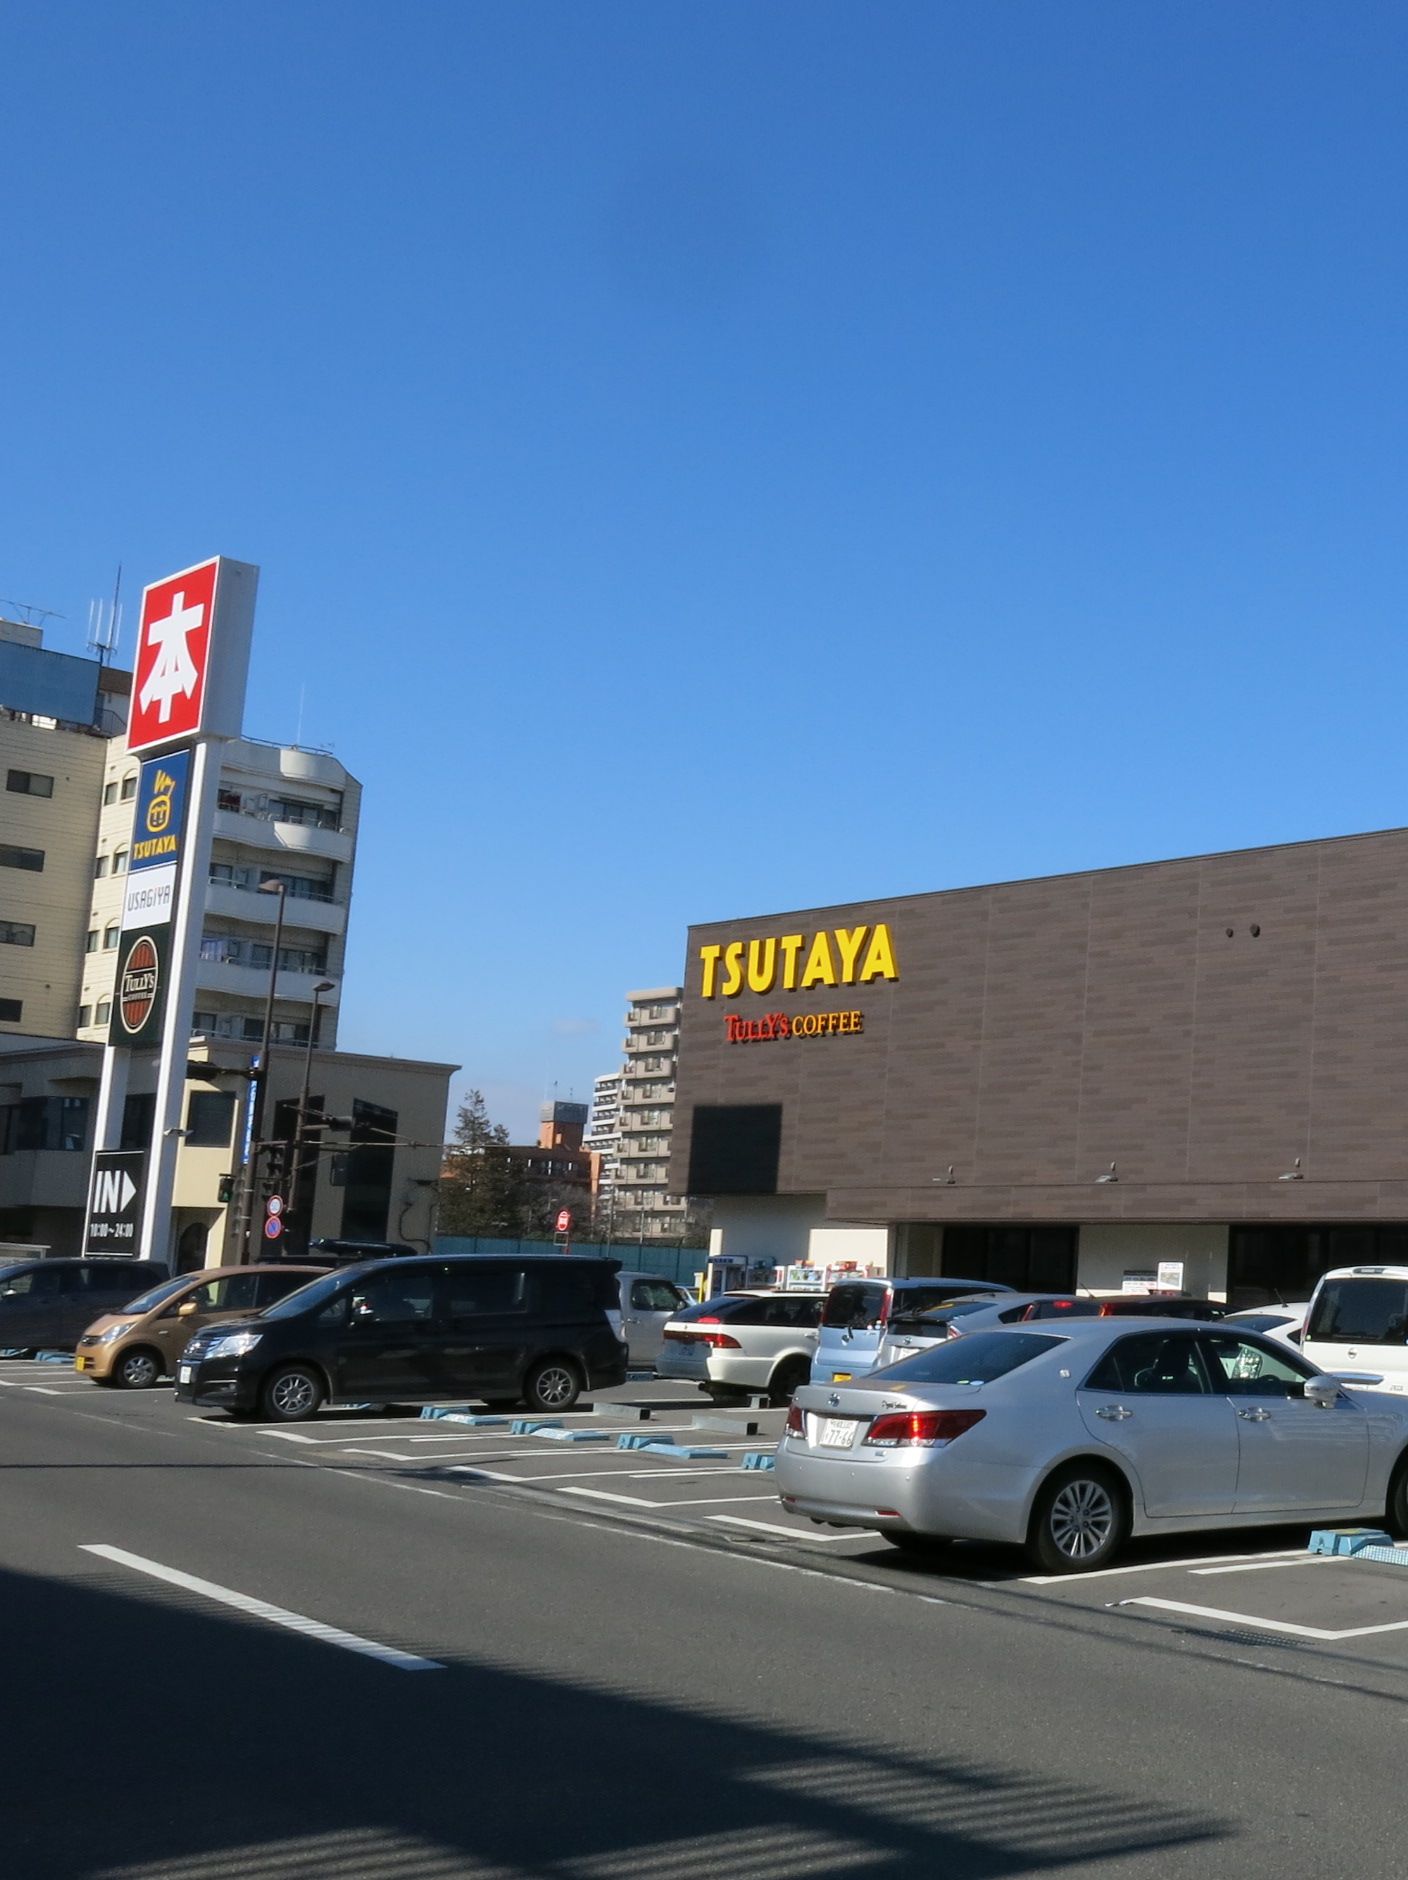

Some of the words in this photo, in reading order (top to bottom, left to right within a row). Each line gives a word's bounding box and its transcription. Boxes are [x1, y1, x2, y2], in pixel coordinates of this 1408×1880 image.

[139, 591, 205, 724] 本
[133, 834, 177, 860] TSUTAYA
[127, 884, 171, 912] USAGIYA
[700, 923, 898, 999] TSUTAYA
[791, 1010, 862, 1037] COFFEE
[93, 1170, 121, 1213] IN
